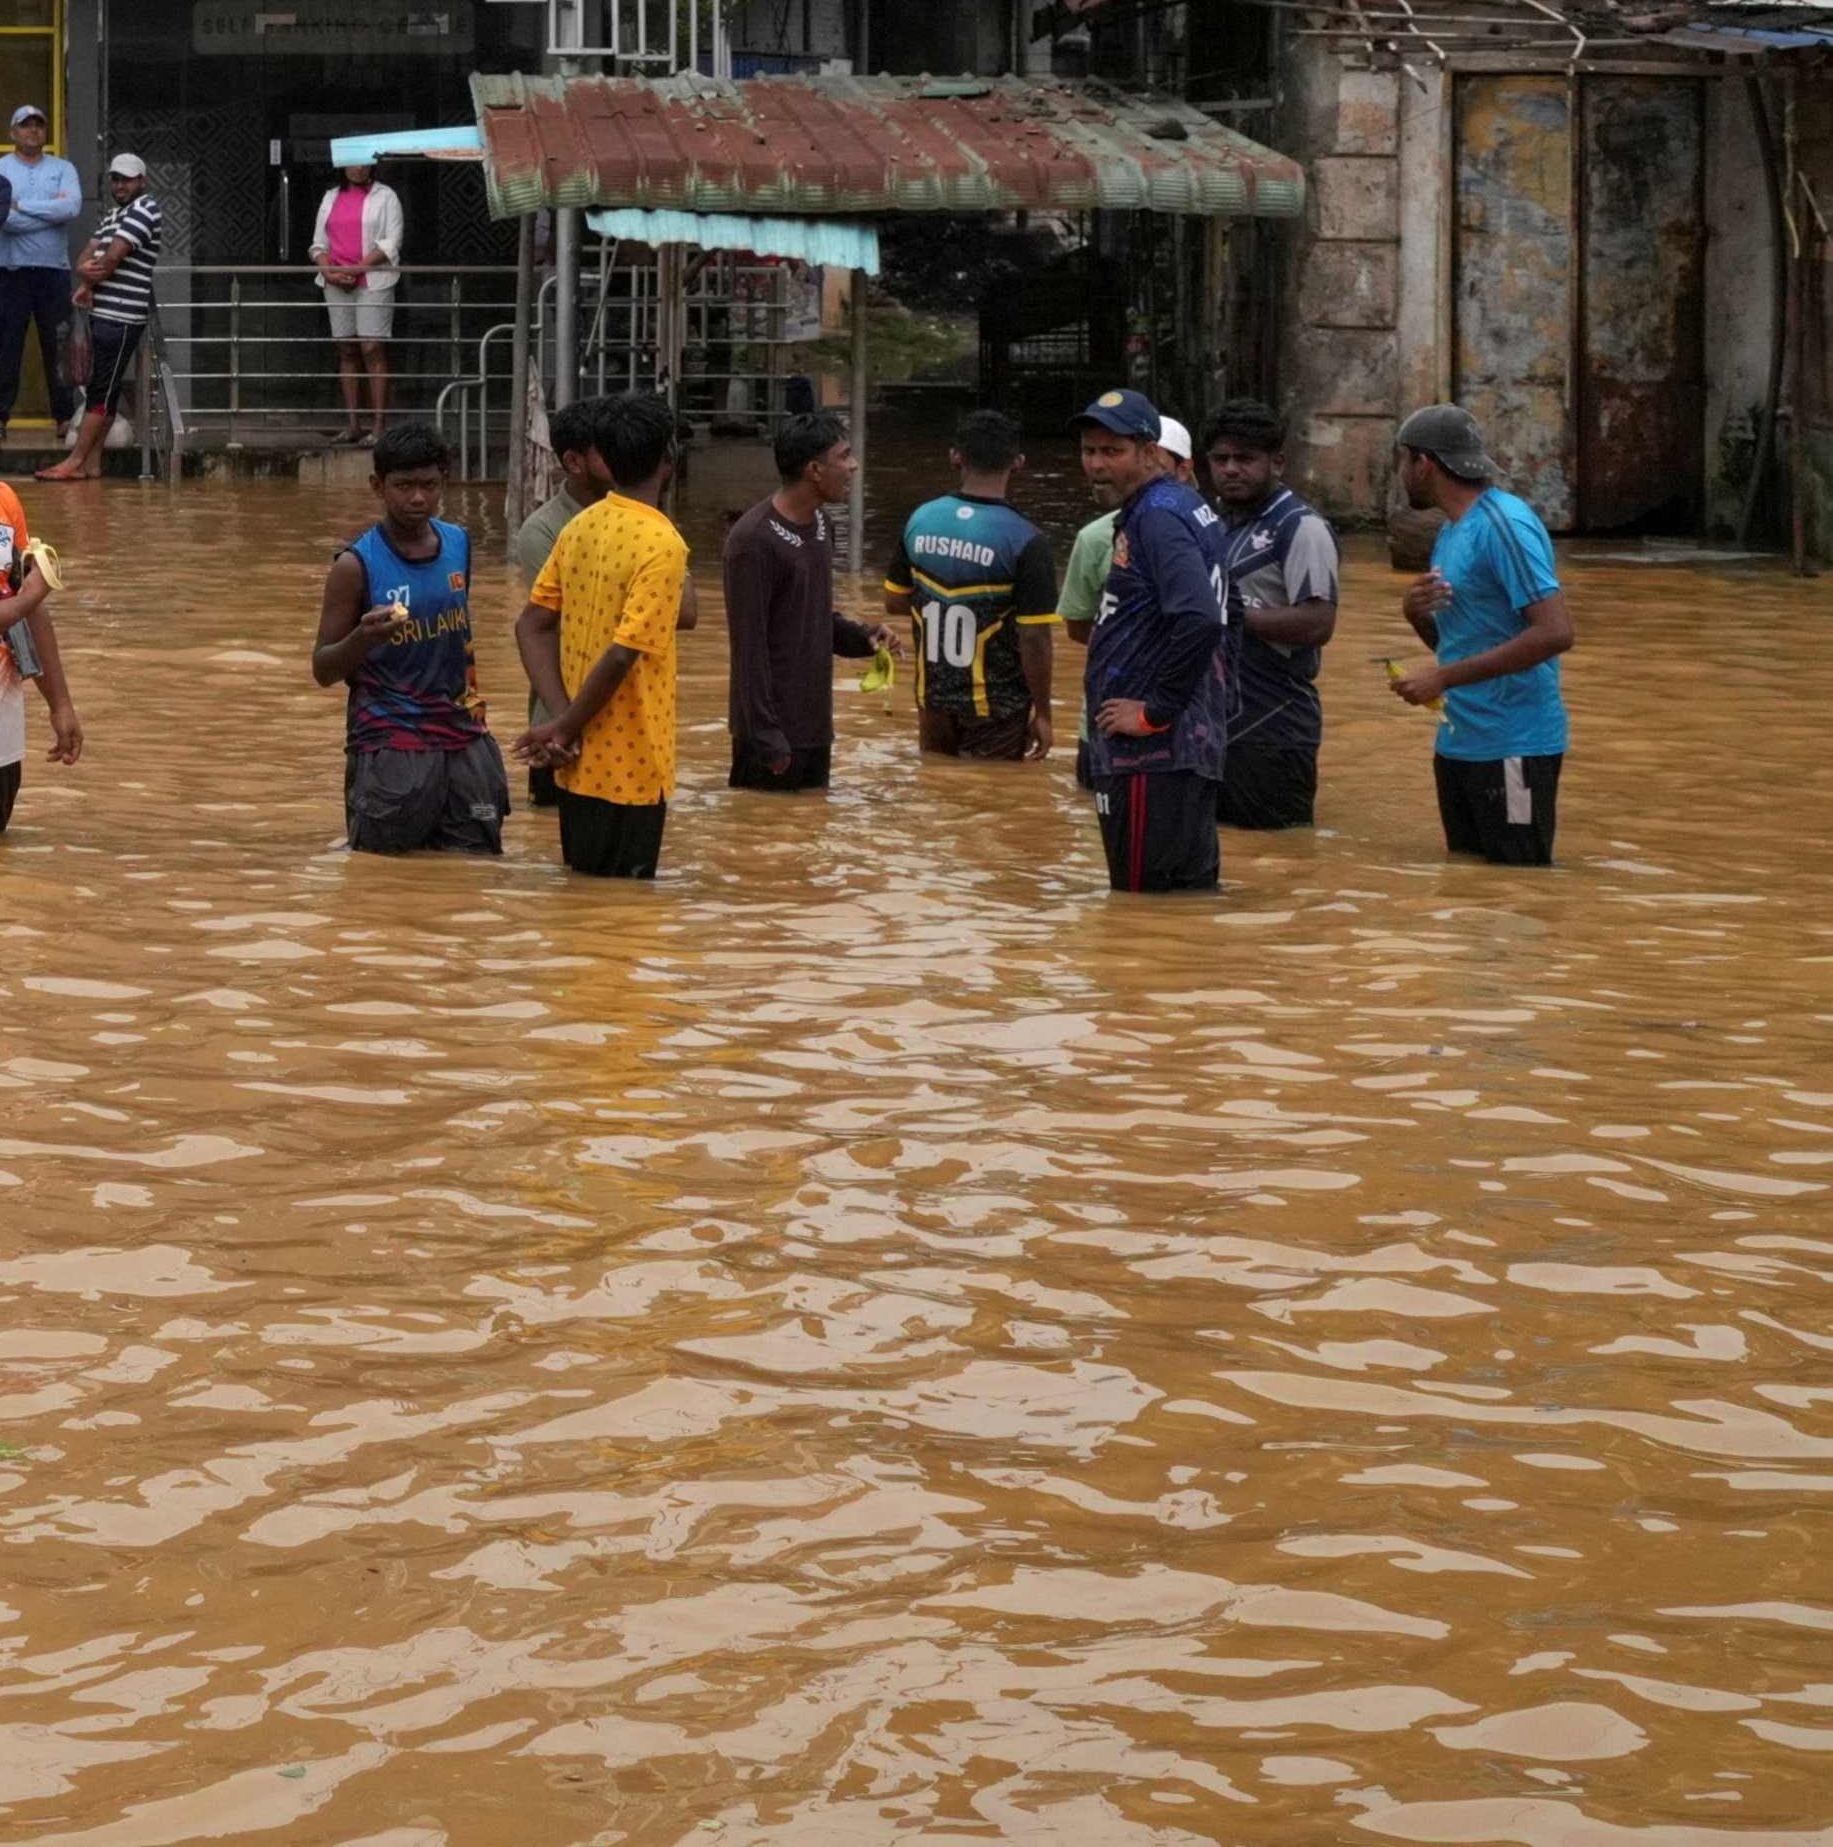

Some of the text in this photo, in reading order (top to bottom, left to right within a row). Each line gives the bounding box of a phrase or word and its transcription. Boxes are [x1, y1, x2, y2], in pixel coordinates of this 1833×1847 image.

[915, 535, 995, 567] RUSHAID
[390, 617, 422, 646] SRI
[921, 600, 977, 667] 10
